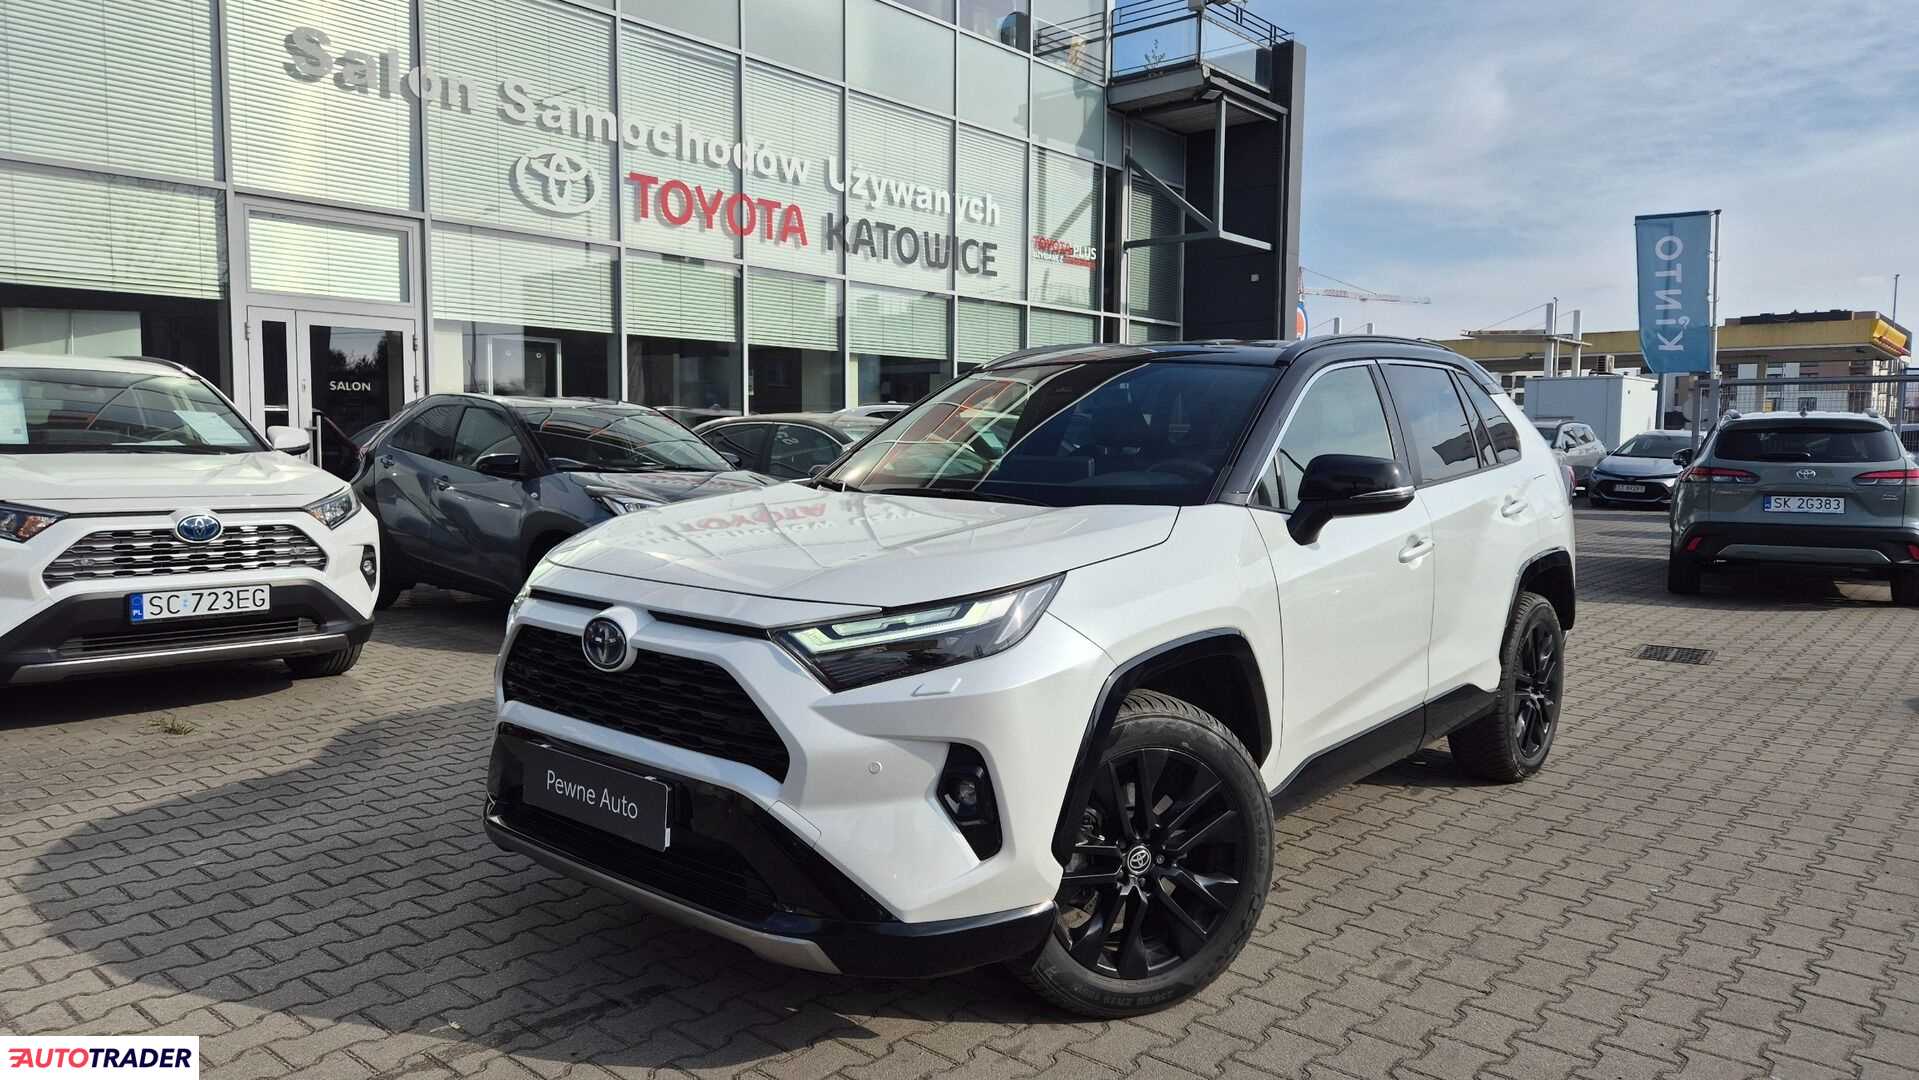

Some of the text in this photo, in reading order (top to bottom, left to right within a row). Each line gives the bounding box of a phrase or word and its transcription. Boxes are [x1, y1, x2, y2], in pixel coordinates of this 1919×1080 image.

[286, 26, 1001, 226] Salon Samochodów Używanych
[628, 171, 998, 277] TOYOTA KATOWICE
[1073, 245, 1097, 260] PLUS
[329, 380, 371, 392] SALON
[1774, 498, 1793, 509] SK
[1797, 498, 1841, 510] 2G383
[149, 595, 181, 616] SC
[191, 588, 266, 613] 723EG
[546, 769, 638, 820] Pewne Auto
